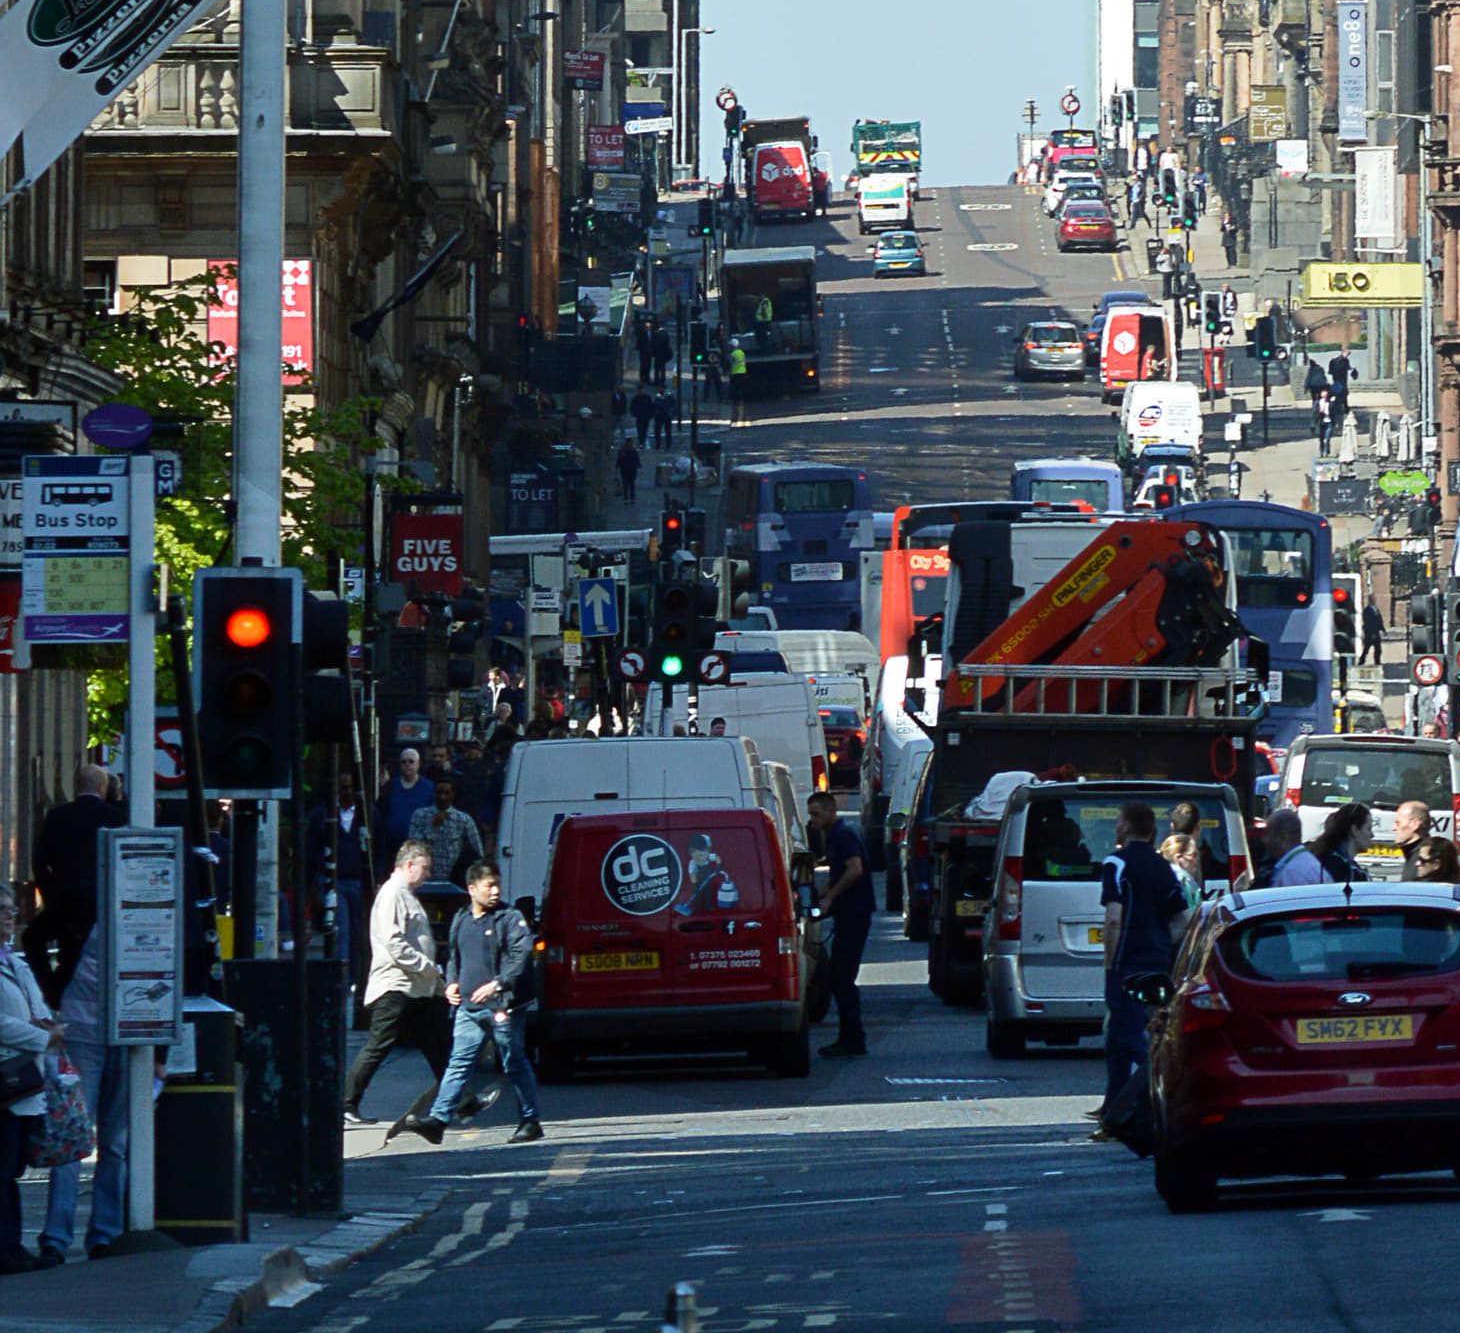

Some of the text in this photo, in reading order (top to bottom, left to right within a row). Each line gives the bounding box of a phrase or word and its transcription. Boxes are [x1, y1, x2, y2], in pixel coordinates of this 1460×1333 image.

[104, 2, 194, 86] Pizzeria
[589, 134, 624, 144] TO LET
[1328, 272, 1370, 292] 150
[511, 488, 554, 501] TO LET
[35, 513, 118, 533] Bus Stop
[403, 539, 451, 554] FIVE
[397, 556, 457, 572] GUYS
[1055, 549, 1113, 605] PALFINGER
[612, 844, 669, 883] dc
[617, 875, 670, 895] CLEANING
[620, 886, 671, 904] SERVICES
[625, 952, 653, 968] NRN
[1305, 1017, 1403, 1039] SM62 FYX
